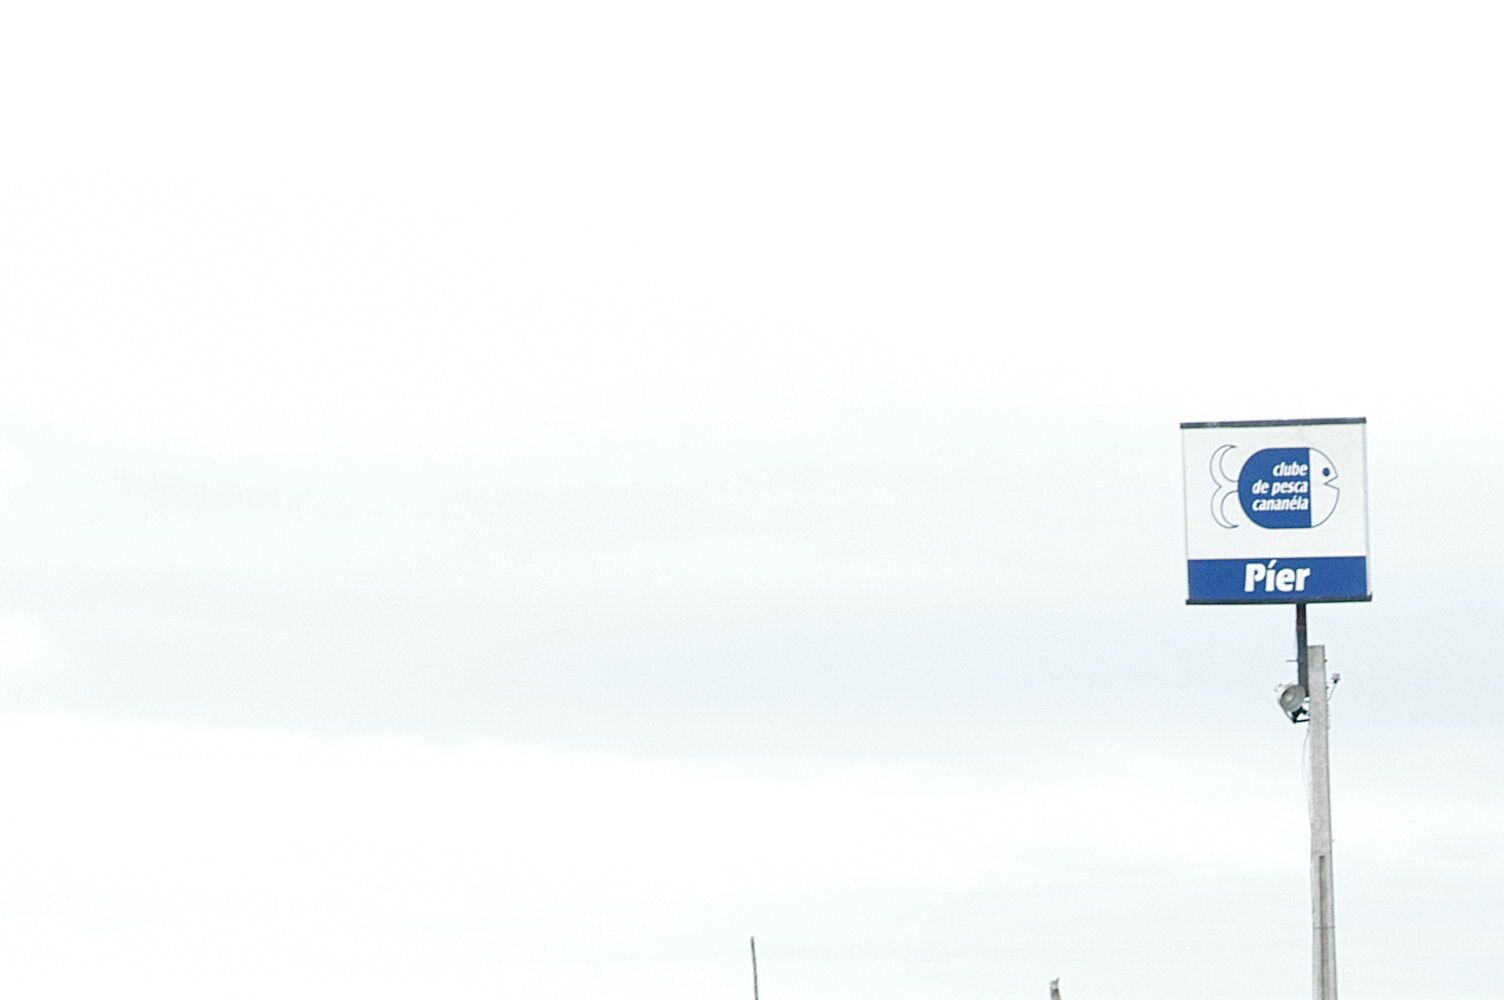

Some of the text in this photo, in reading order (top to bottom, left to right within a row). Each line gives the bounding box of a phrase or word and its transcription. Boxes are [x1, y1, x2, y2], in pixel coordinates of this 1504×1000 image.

[1272, 461, 1308, 477] clube
[1251, 479, 1309, 496] de pesca
[1252, 495, 1309, 511] cananéia
[1244, 559, 1311, 592] Píer
